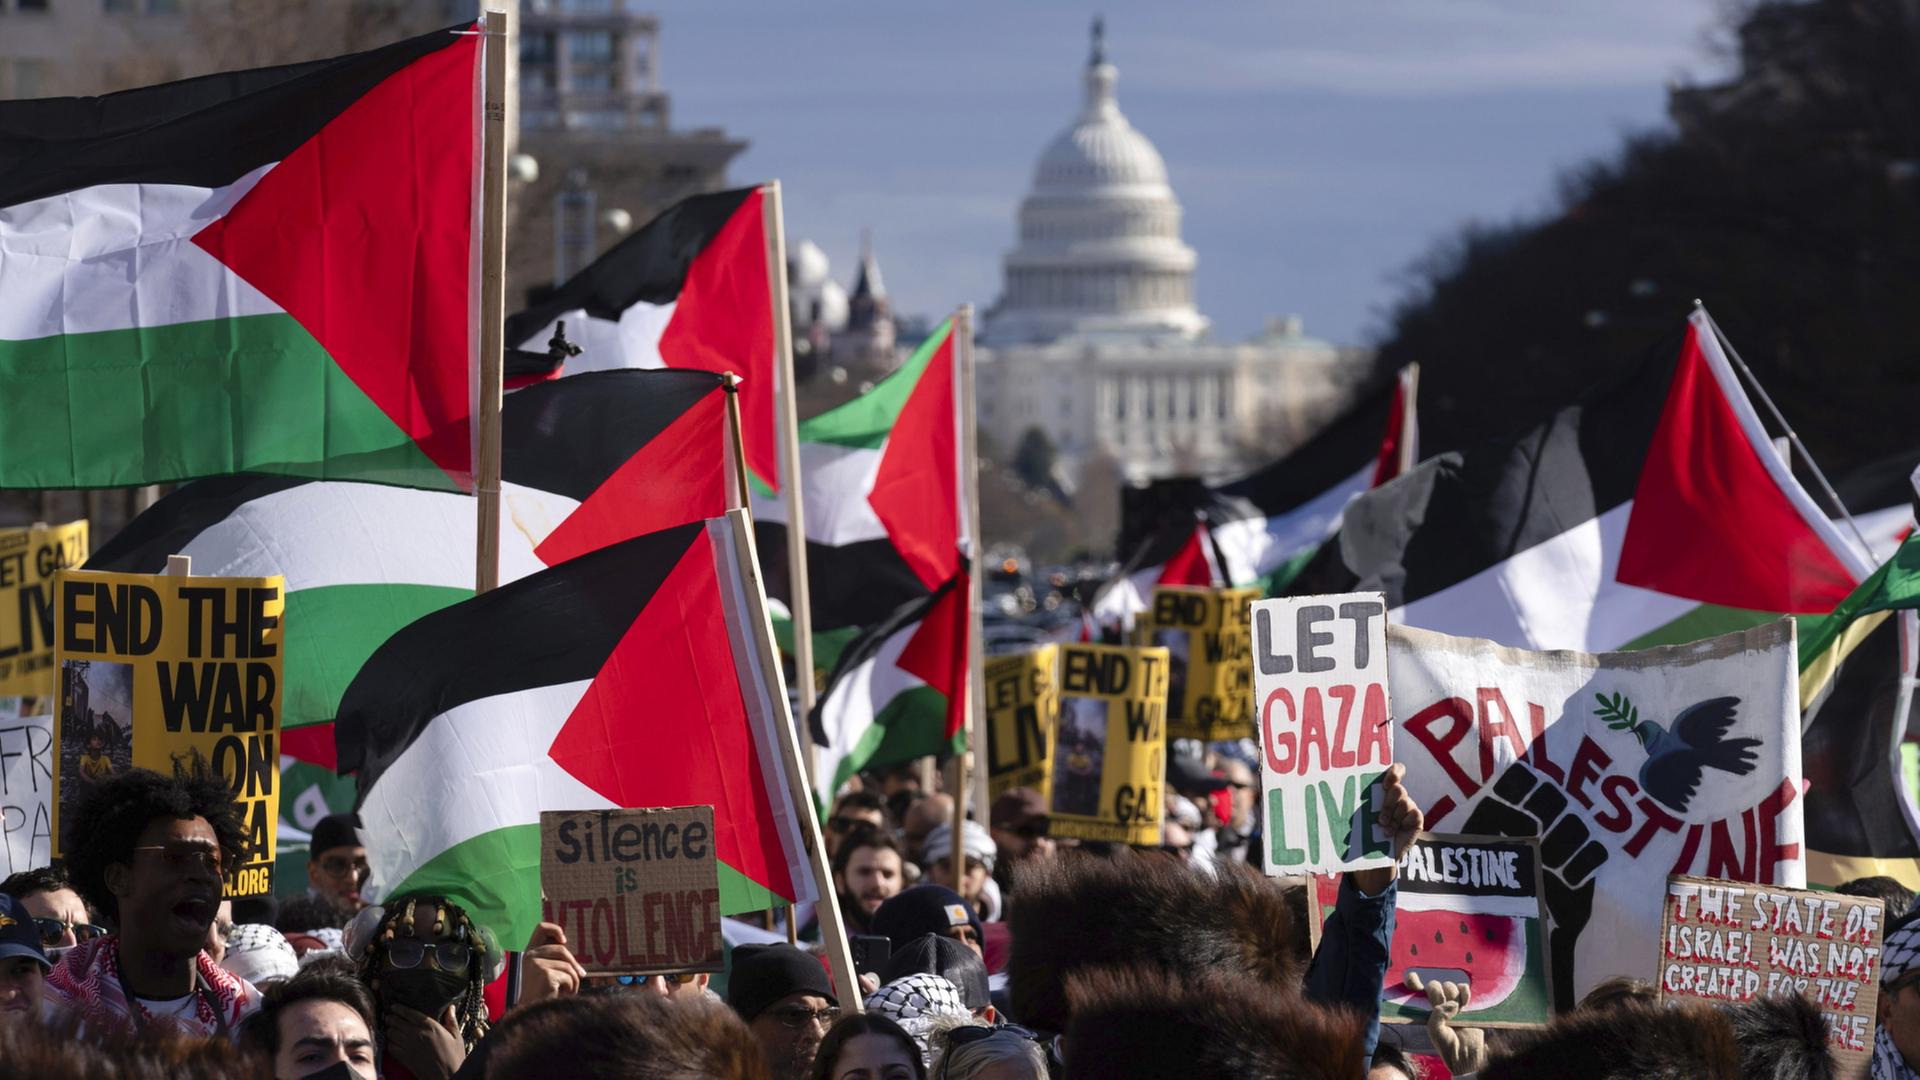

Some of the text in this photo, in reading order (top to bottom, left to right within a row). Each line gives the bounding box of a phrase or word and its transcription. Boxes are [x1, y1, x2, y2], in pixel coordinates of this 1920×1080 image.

[0, 552, 27, 587] ET
[0, 583, 54, 658] IV
[64, 581, 278, 659] END THE
[1156, 592, 1206, 627] END
[1256, 602, 1383, 675] LET
[157, 661, 275, 733] WAR
[1063, 650, 1130, 694] END
[0, 725, 52, 795] FR
[985, 705, 1047, 777] LIV
[1263, 683, 1391, 776] GAZA
[212, 733, 273, 797] ON
[1402, 687, 1800, 884] PALESTINE
[2, 801, 51, 873] PA
[1115, 784, 1158, 827] GAZ
[1268, 772, 1391, 865] LIVE
[555, 813, 708, 864] Silence
[222, 867, 269, 898] N.ORG
[614, 867, 639, 894] is
[1669, 882, 1882, 943] THE STATE OF
[1666, 924, 1879, 983] ISRAEL WAS NOT
[1664, 964, 1761, 1000] CREATED
[1815, 978, 1860, 1010] THE
